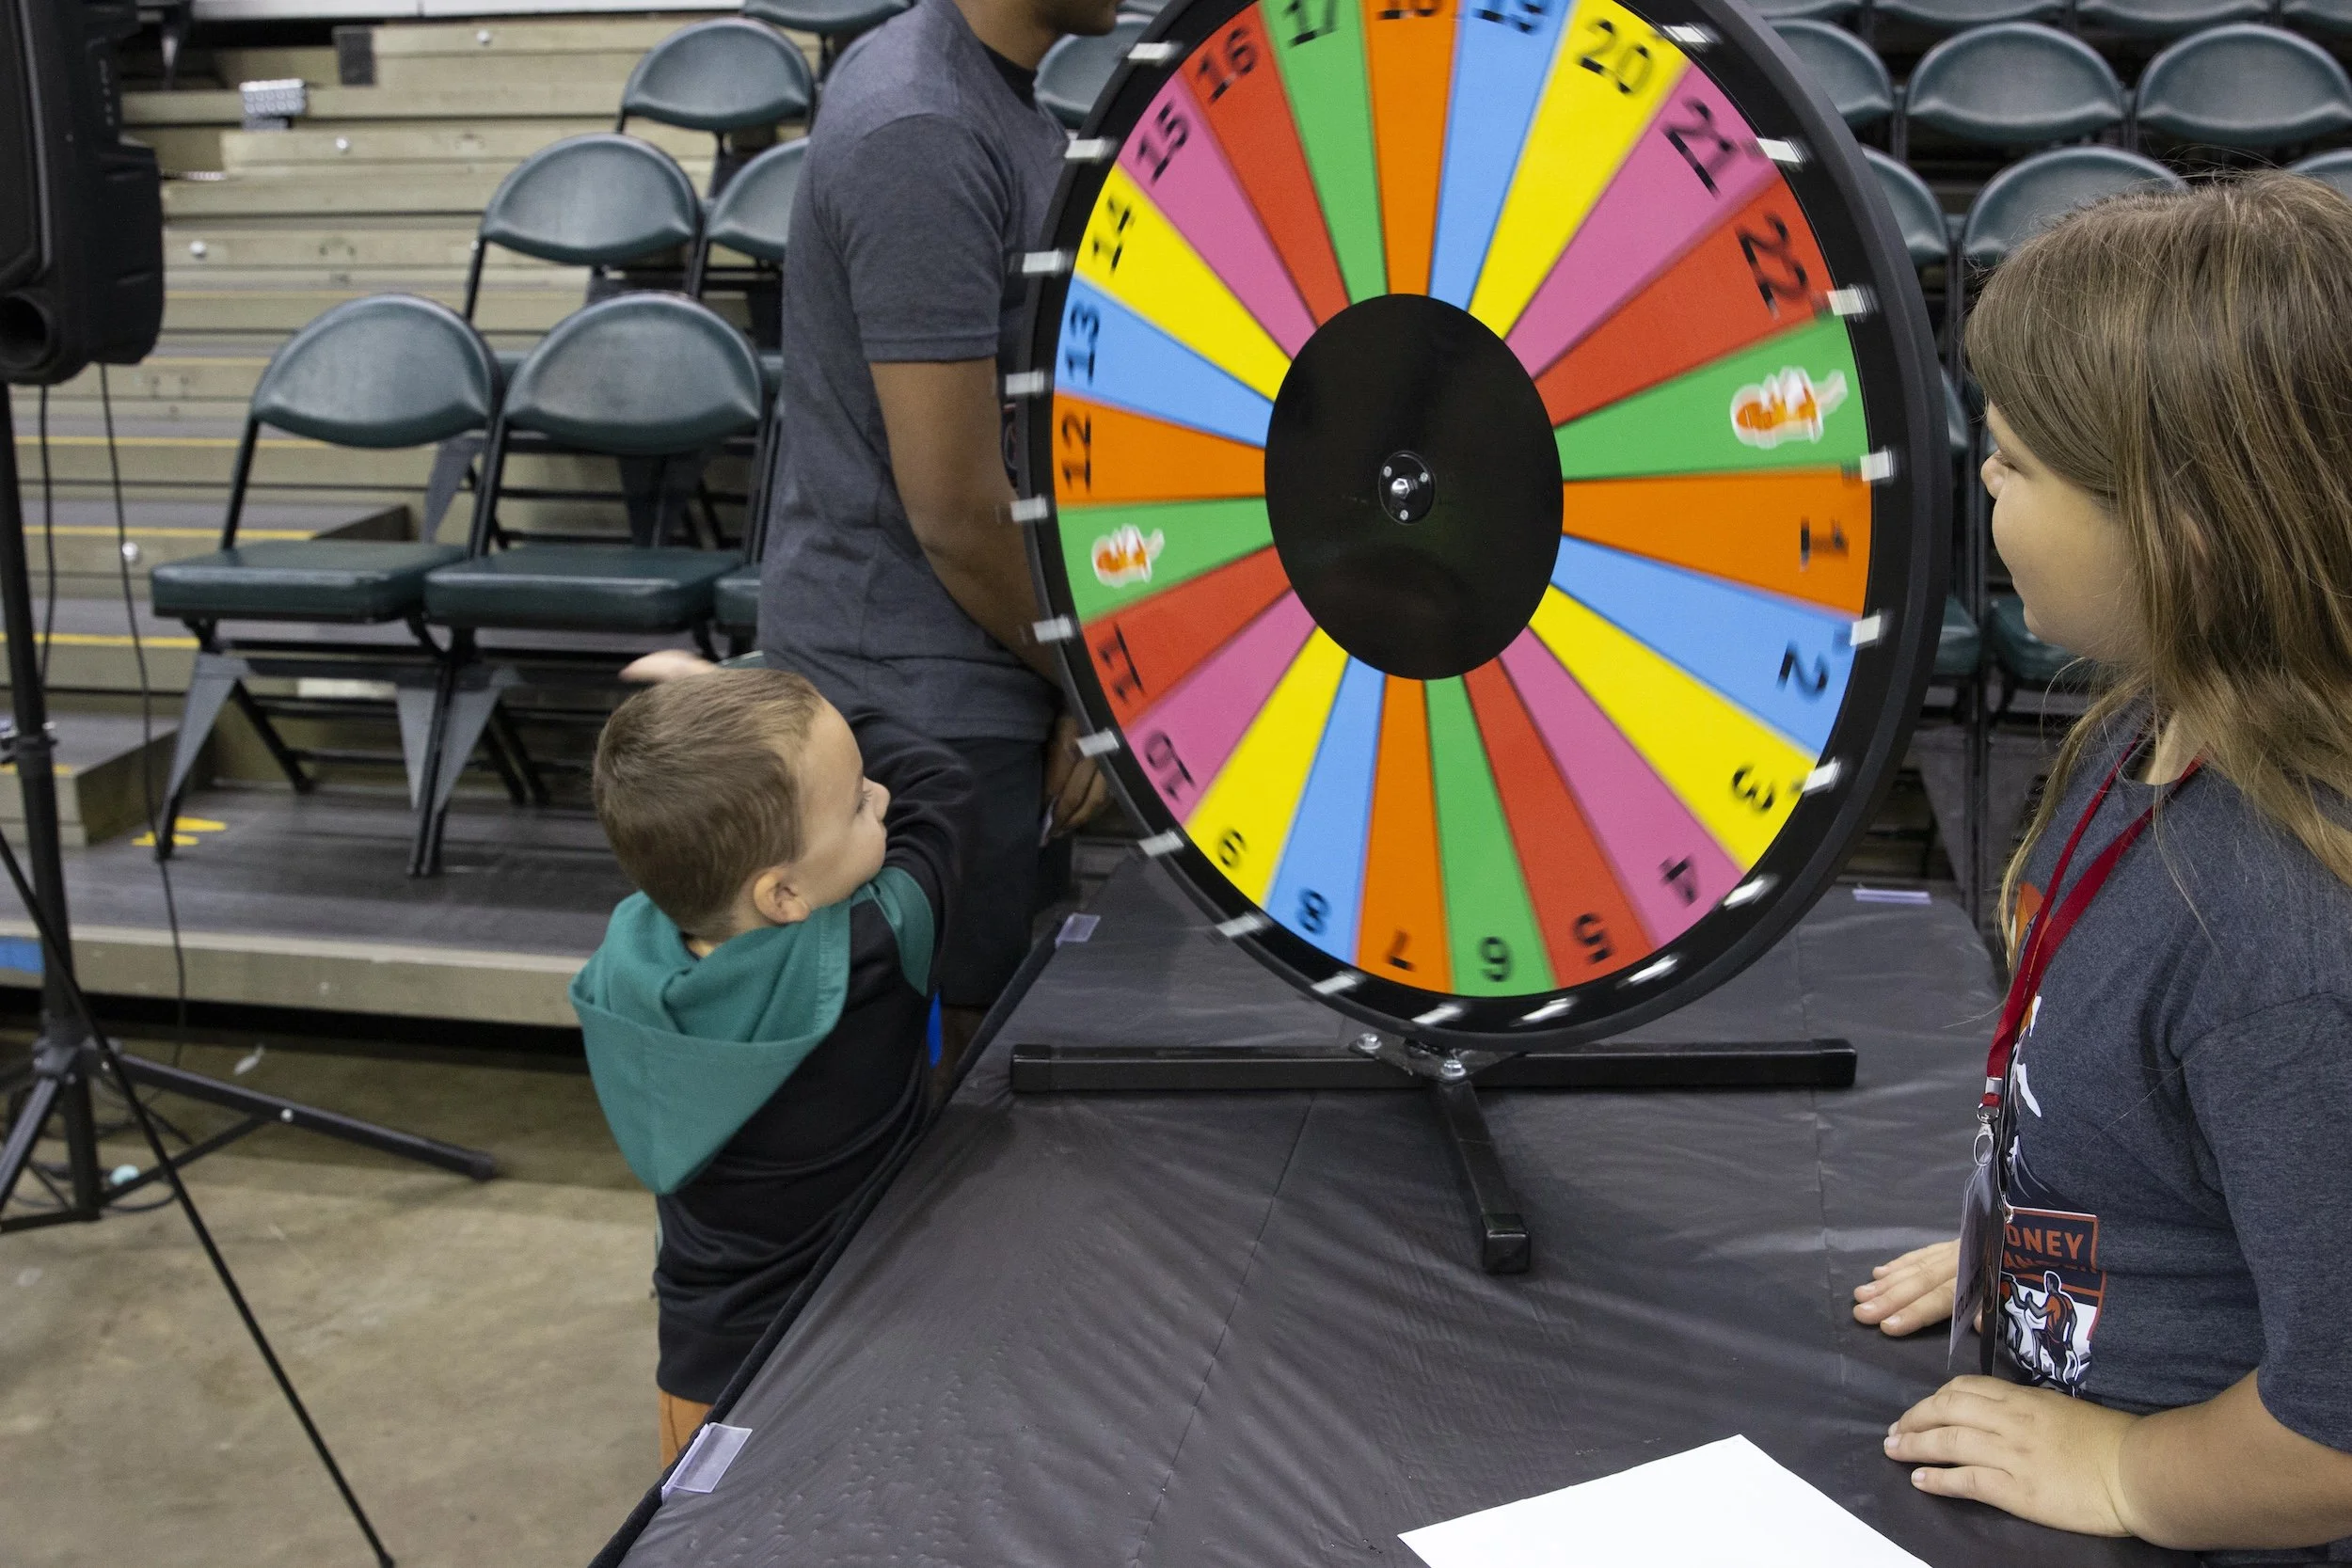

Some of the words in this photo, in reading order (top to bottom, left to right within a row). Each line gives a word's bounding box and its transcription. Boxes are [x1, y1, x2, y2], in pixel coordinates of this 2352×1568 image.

[1196, 26, 1258, 103] 16
[1577, 17, 1653, 95] 20
[1136, 100, 1190, 184] 15
[1662, 97, 1739, 197] 21
[1092, 194, 1136, 277] 14
[1736, 213, 1809, 320] 22
[1067, 301, 1099, 386] 13
[1062, 411, 1091, 495] 12
[1800, 517, 1850, 571] 1
[1097, 624, 1145, 703] 11
[1777, 641, 1829, 702] 2
[1144, 730, 1196, 803] 10
[1731, 765, 1775, 814] 3
[1297, 889, 1329, 936] 8
[1661, 857, 1699, 907] 4
[1387, 930, 1416, 973] 7
[1479, 937, 1513, 983] 6
[1573, 912, 1614, 965] 5
